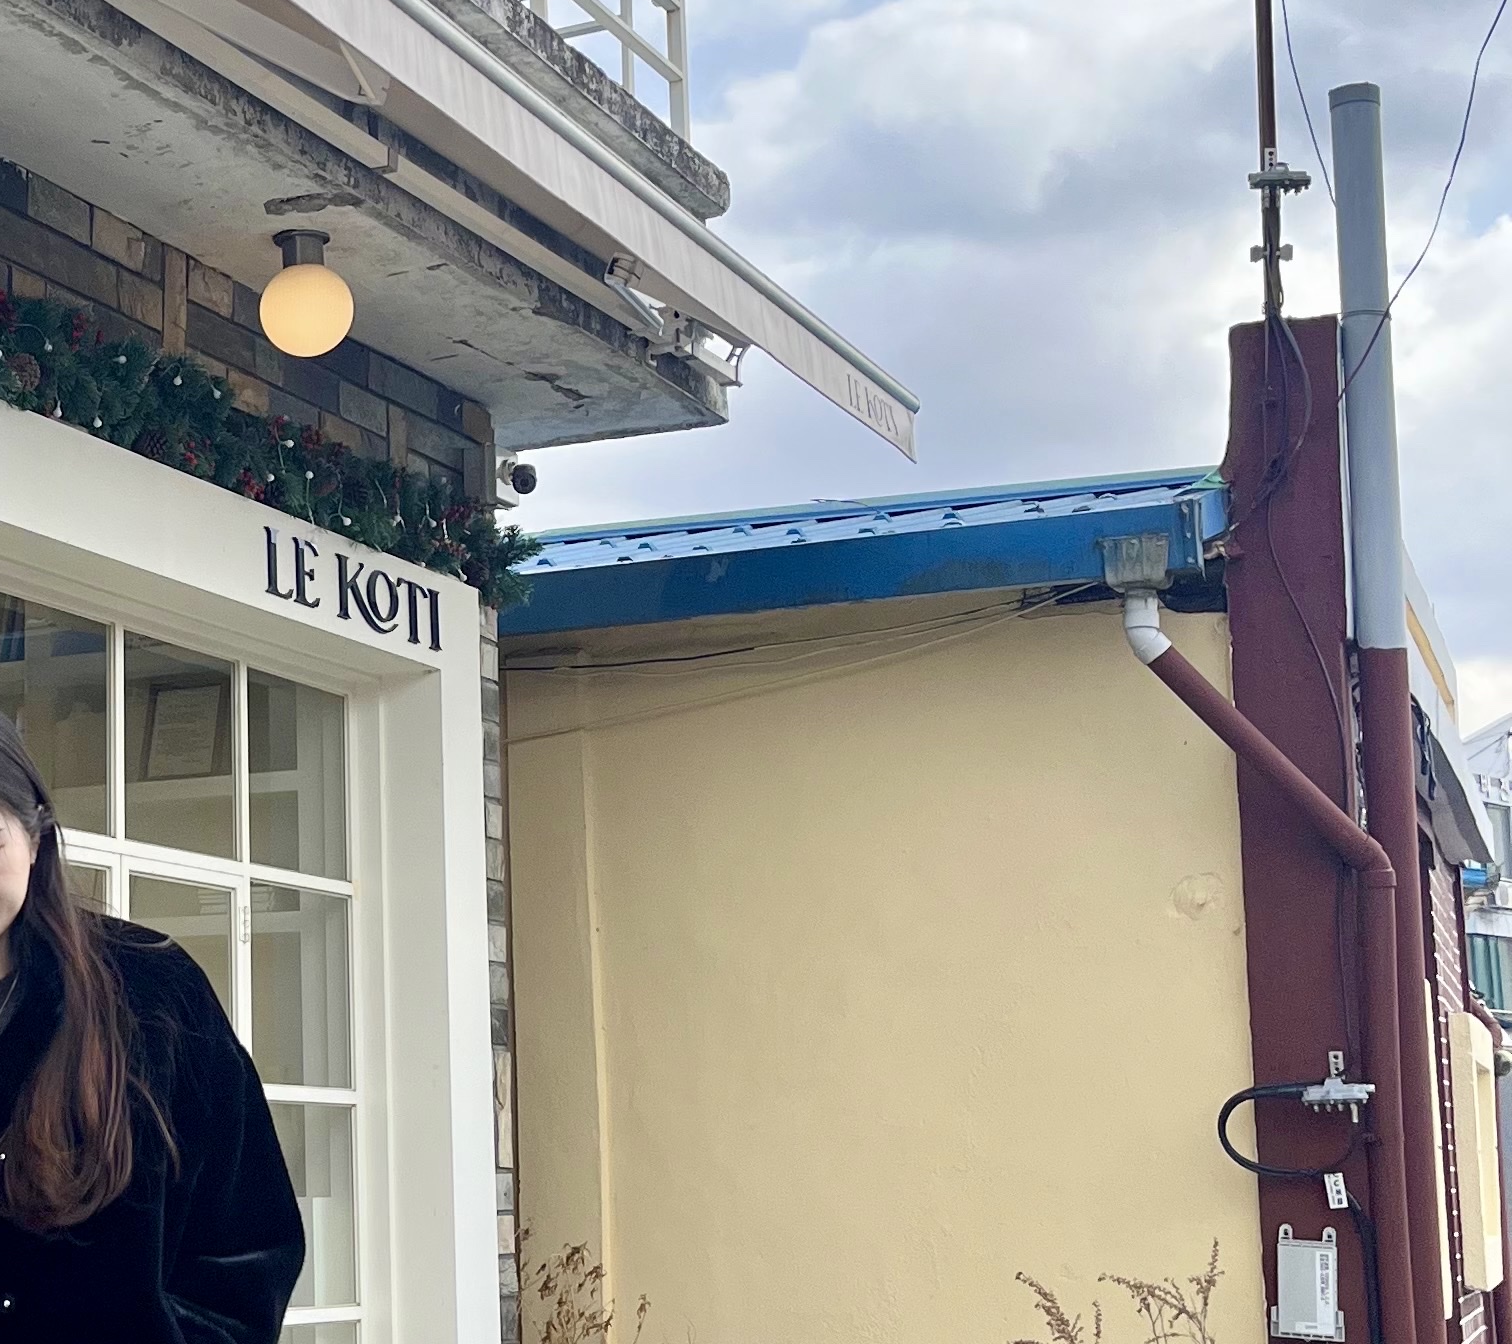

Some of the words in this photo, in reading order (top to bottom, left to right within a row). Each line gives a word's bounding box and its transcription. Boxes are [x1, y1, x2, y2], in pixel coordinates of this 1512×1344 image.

[846, 373, 864, 415] LE
[864, 386, 899, 437] KOTI
[263, 525, 321, 609] LE
[334, 552, 443, 652] KOTI
